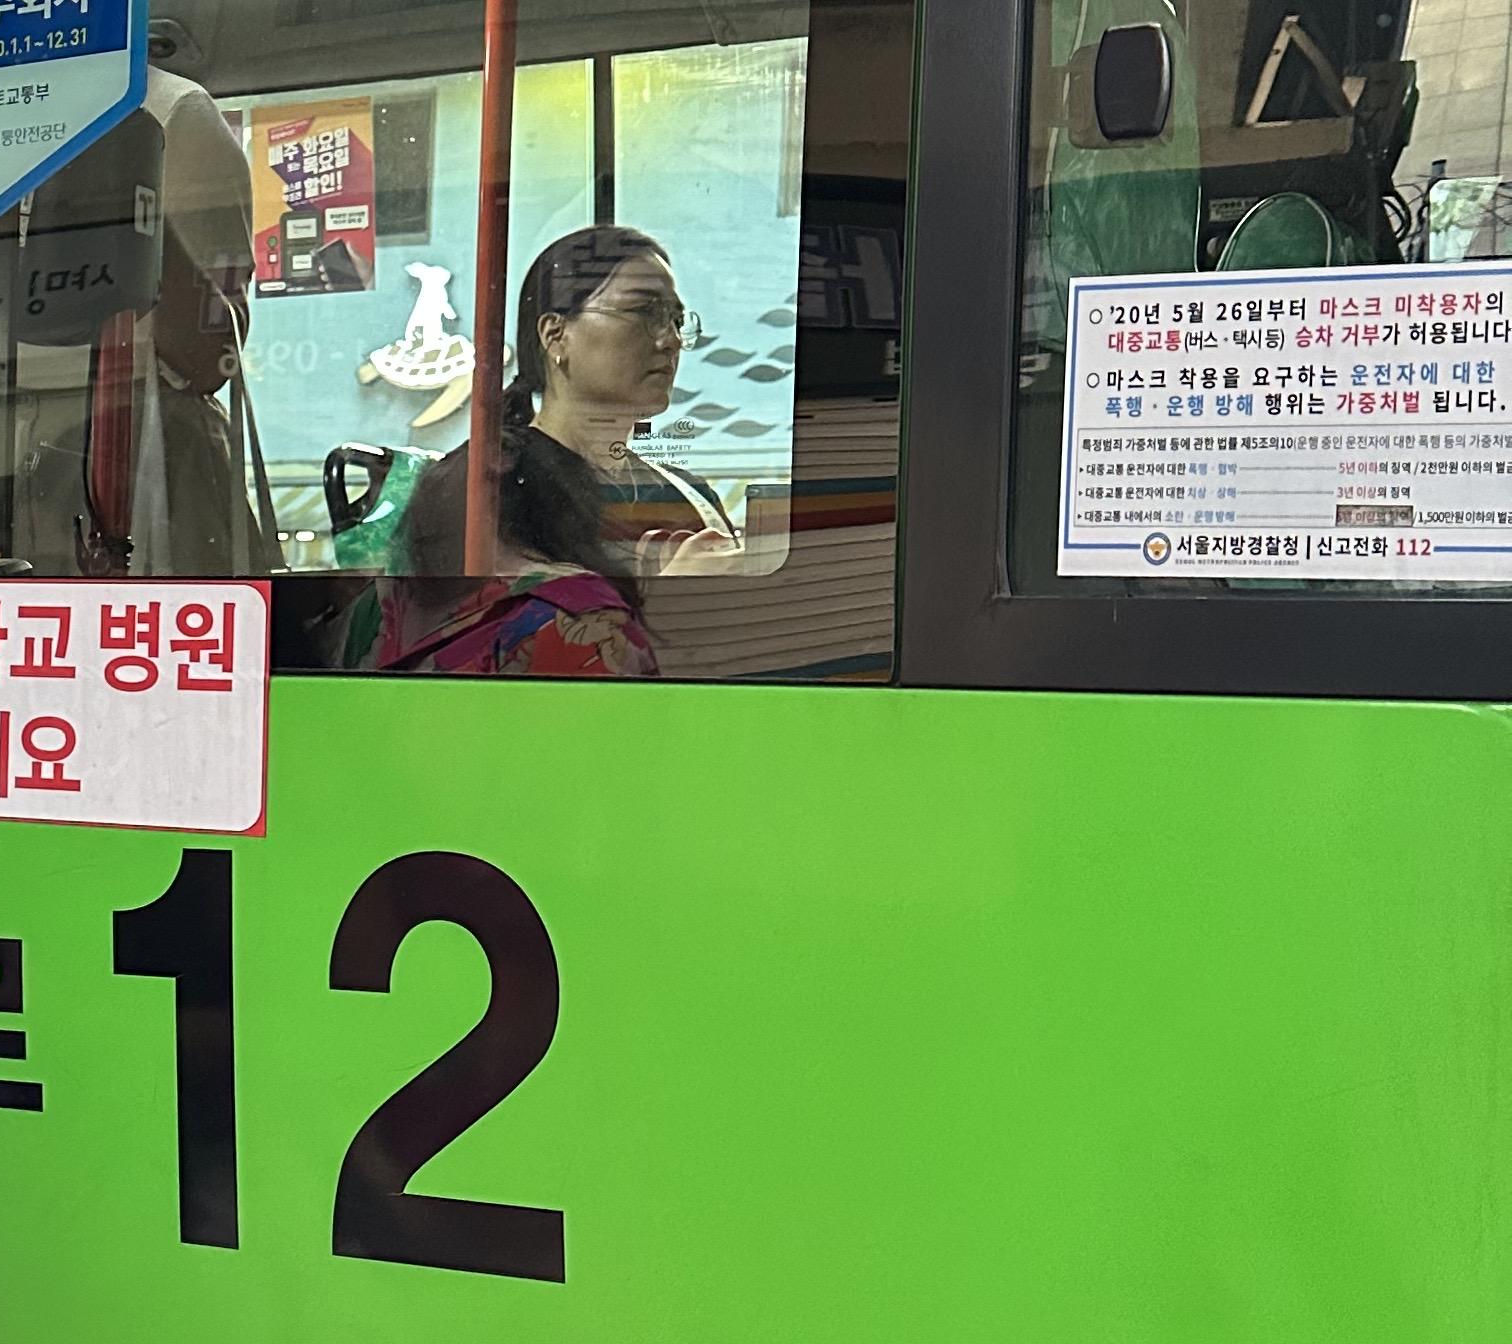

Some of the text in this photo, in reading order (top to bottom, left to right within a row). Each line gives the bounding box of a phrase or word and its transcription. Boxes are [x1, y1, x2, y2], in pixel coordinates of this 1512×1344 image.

[1109, 290, 1504, 325] '20년 5월 26일부터 마스크 미착용자의
[1295, 324, 1334, 348] 승차
[1341, 321, 1400, 347] 거부가
[1106, 360, 1496, 392] 마스크 착용을 요구하는 운전자에 대한
[1105, 389, 1506, 419] 폭행 운행 방해 행위는 가중처벌 됩니다.
[1193, 437, 1215, 451] 관한
[1345, 435, 1389, 450] 운전자에
[1393, 434, 1416, 450] 대한
[1086, 462, 1124, 476] 대중교통
[1338, 462, 1356, 476] 5년
[1461, 460, 1493, 475] 이하의
[1085, 486, 1123, 500] 대중교통
[1337, 486, 1353, 499] 3년
[1176, 534, 1432, 558] 서울지방경찰청 신고전화 112
[99, 600, 236, 693] 병원
[112, 847, 567, 1285] 12
